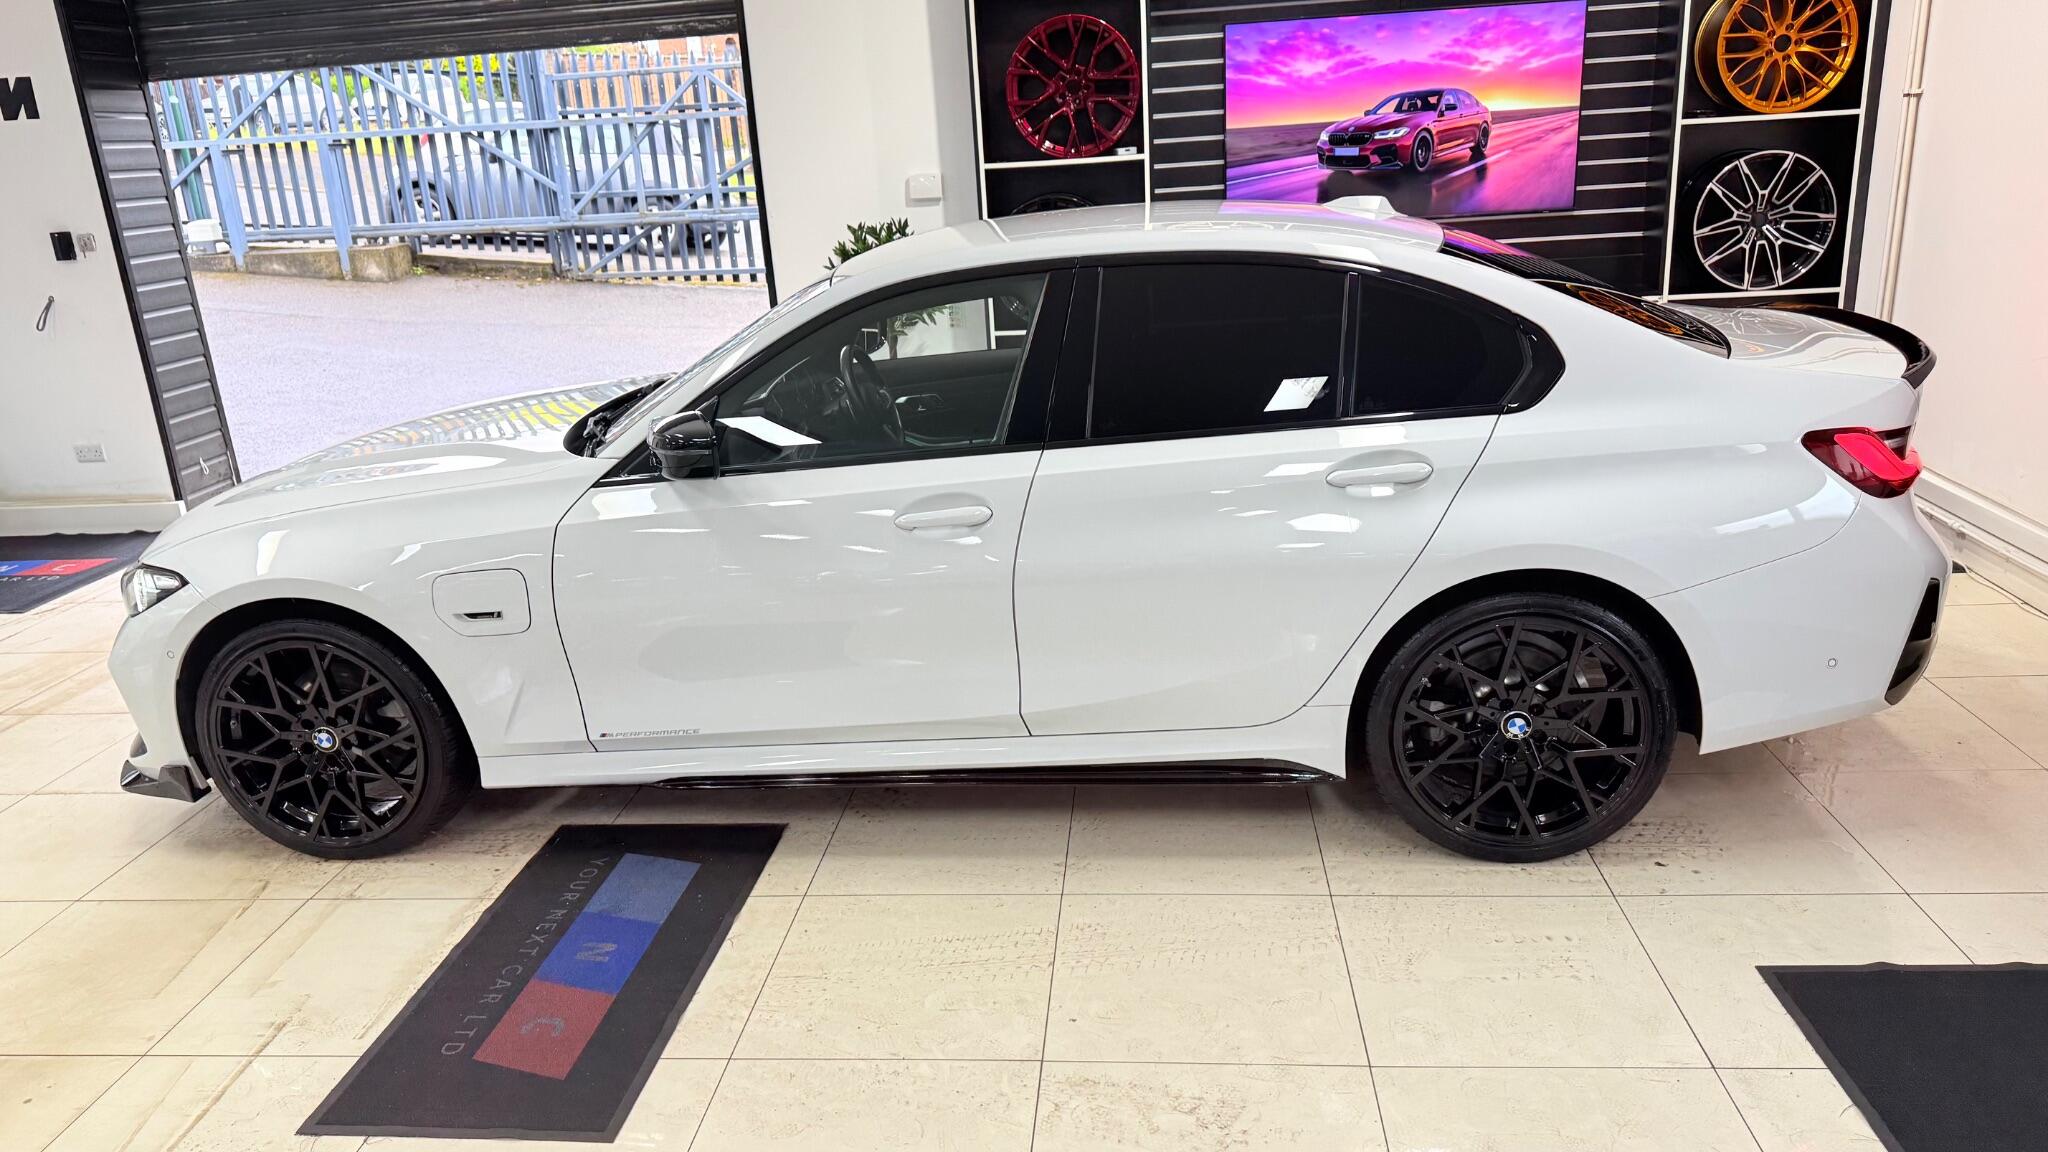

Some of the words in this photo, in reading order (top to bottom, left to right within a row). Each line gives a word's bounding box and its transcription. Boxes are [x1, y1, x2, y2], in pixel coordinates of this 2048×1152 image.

[615, 728, 701, 738] PERFORMANCE
[560, 856, 610, 902] YOUR
[518, 908, 569, 957] NEXT
[480, 964, 523, 1004] CAR
[441, 1015, 488, 1055] LTD
